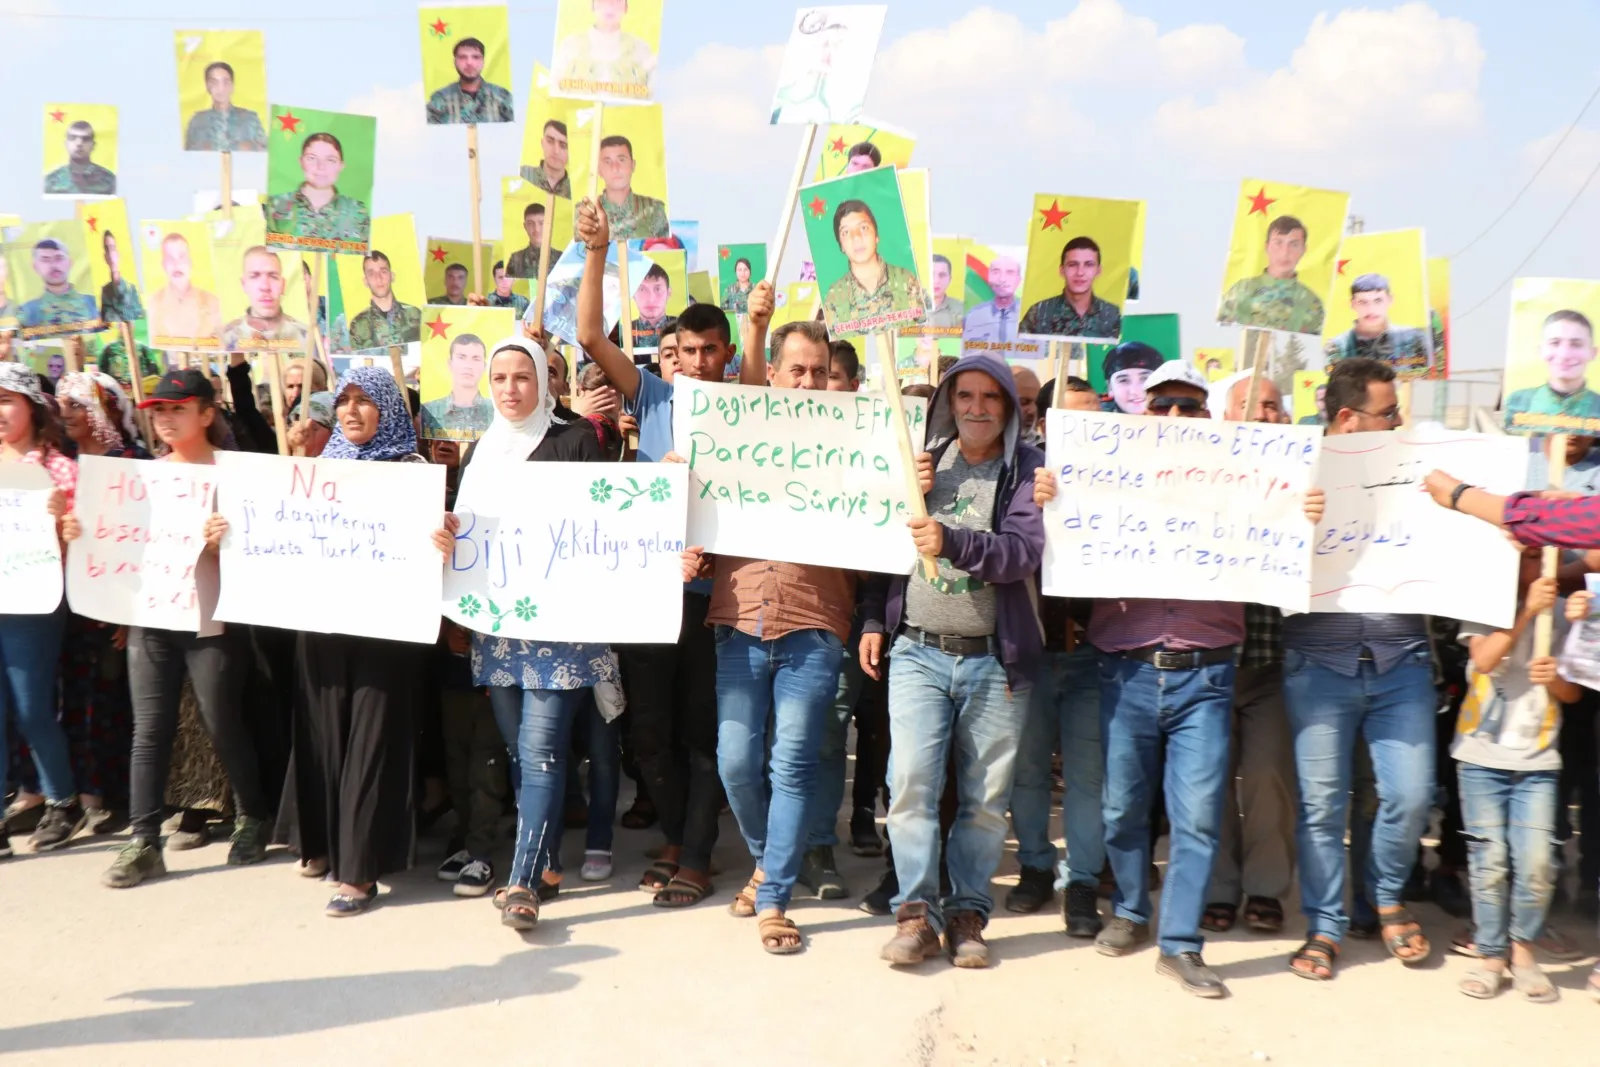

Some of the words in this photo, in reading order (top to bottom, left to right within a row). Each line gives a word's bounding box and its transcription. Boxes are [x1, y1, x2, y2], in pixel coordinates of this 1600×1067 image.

[1061, 415, 1148, 455] Rizgar
[290, 463, 342, 503] Na
[1064, 504, 1103, 530] de
[1213, 512, 1235, 540] bi
[637, 530, 685, 568] gelan
